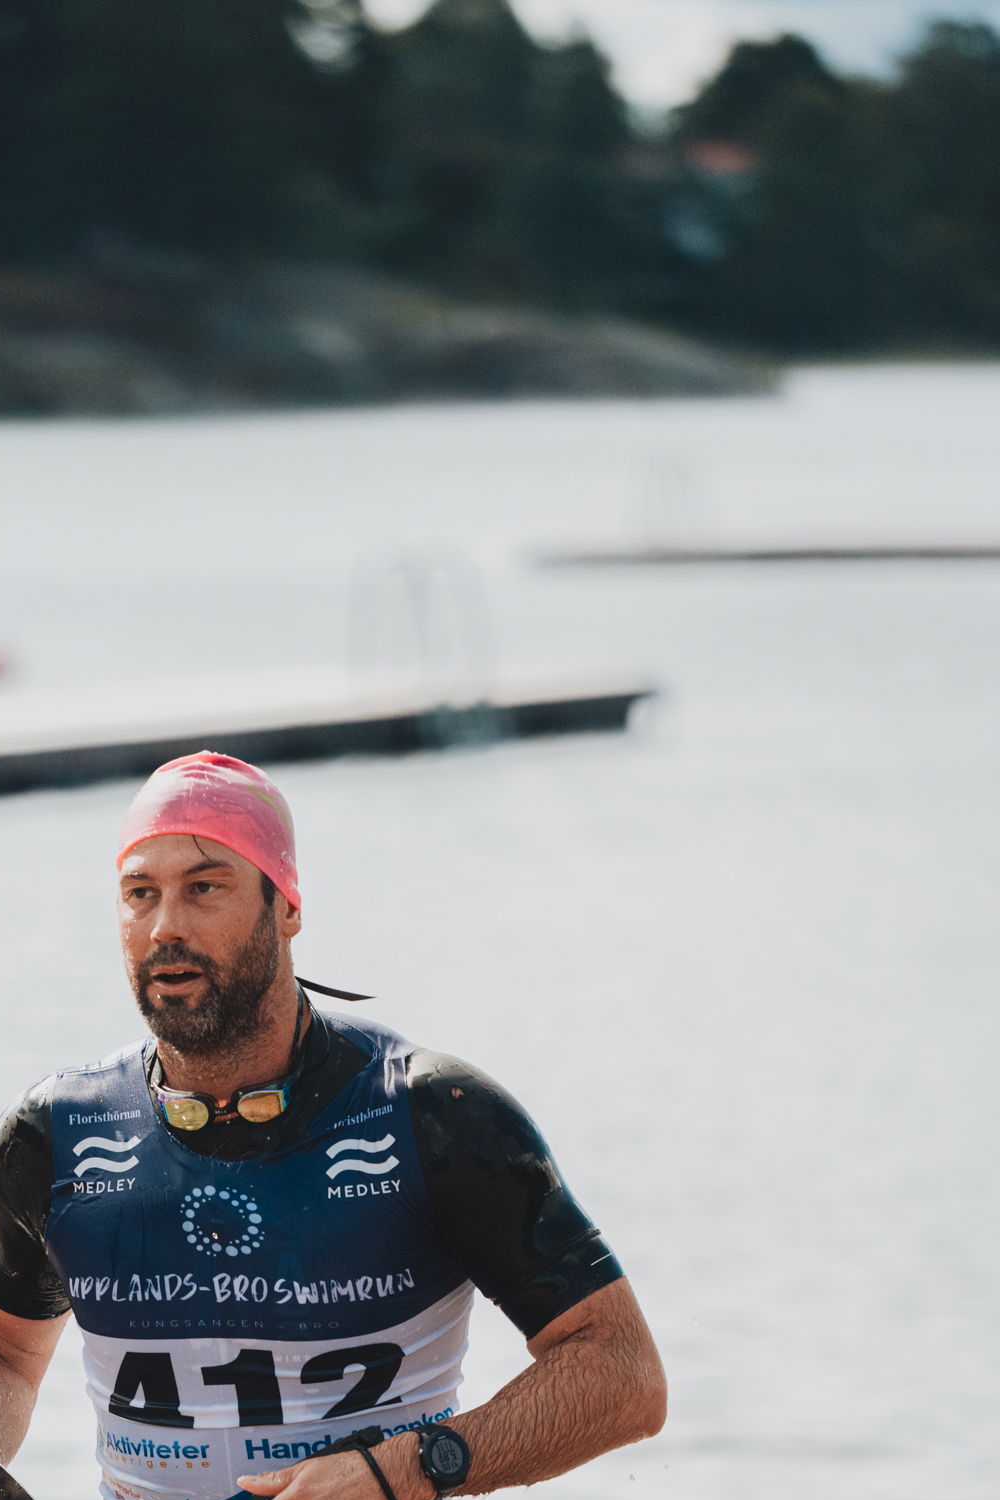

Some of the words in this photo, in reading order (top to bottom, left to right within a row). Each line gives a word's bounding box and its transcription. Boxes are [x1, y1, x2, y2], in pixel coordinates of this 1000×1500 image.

[68, 1109, 141, 1126] Floristhörnan
[72, 1177, 136, 1194] MEDLEY
[327, 1179, 401, 1199] MEDLEY
[108, 1343, 406, 1429] 412
[106, 1432, 210, 1460] Aktiviteter
